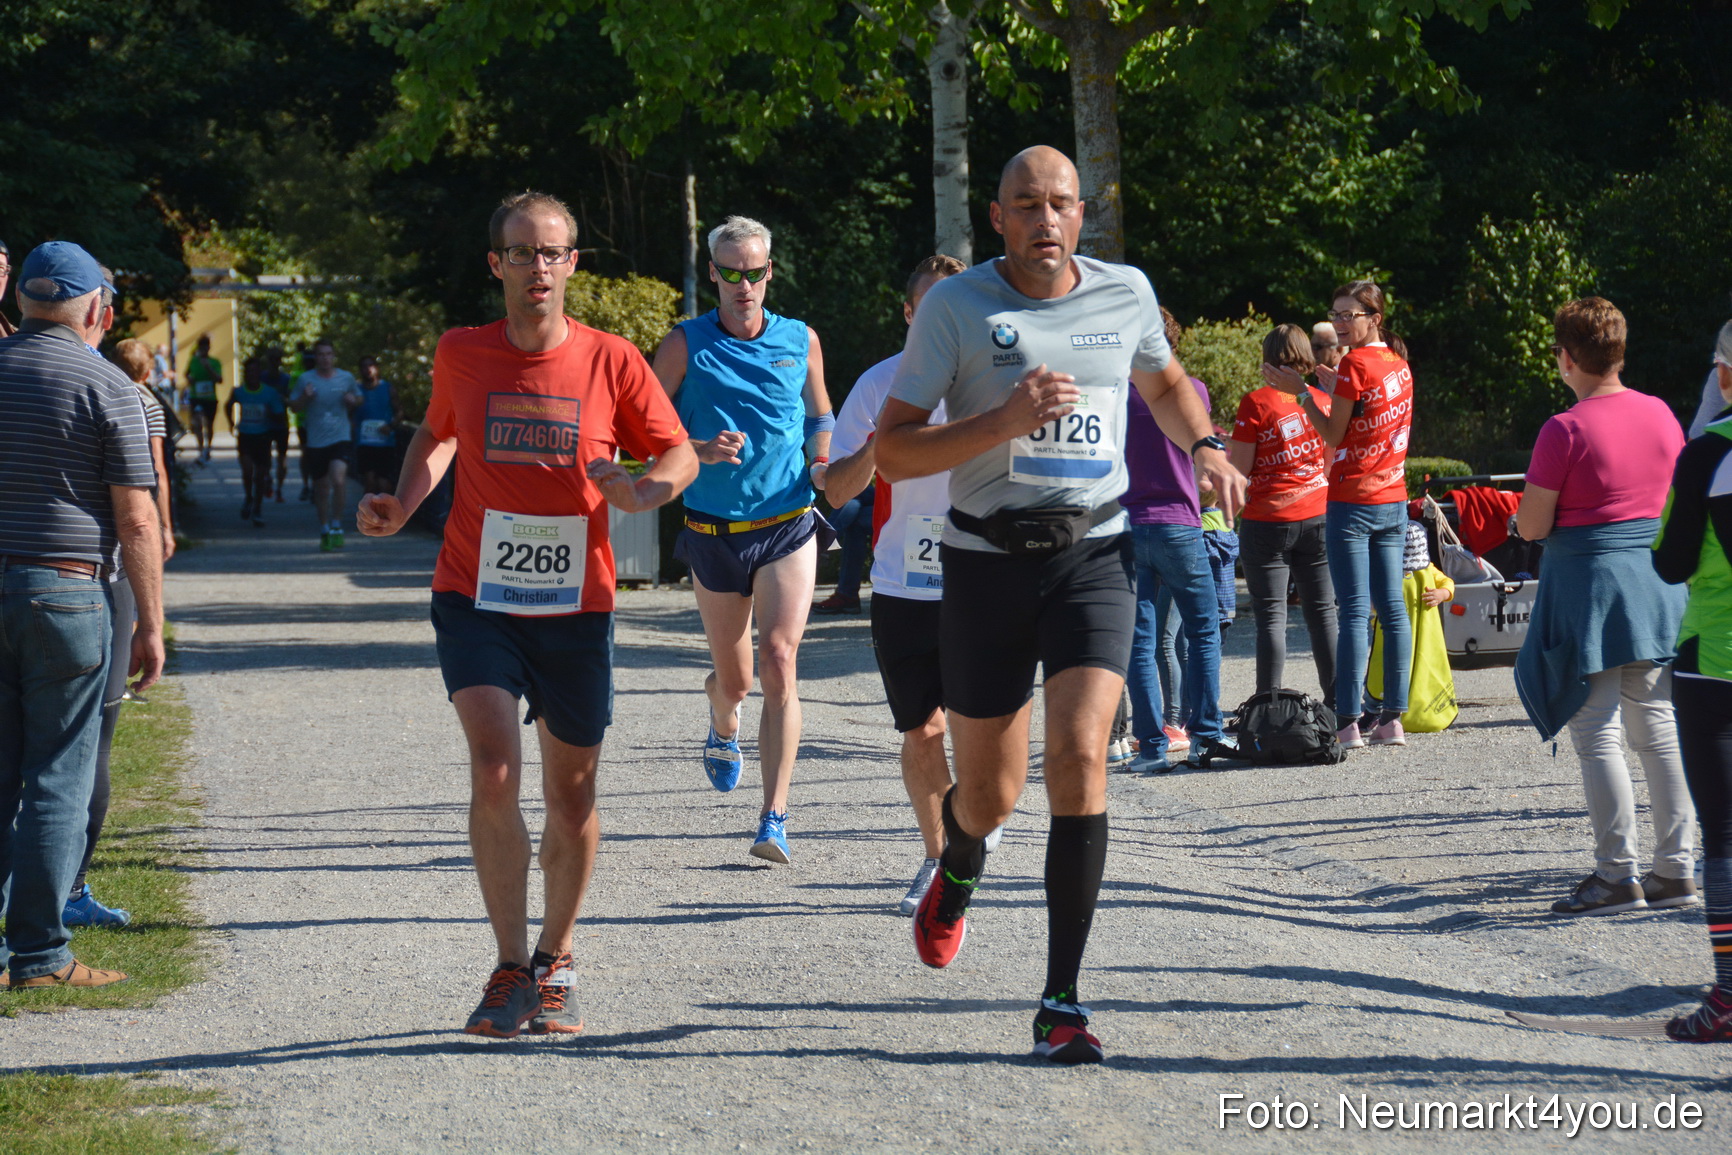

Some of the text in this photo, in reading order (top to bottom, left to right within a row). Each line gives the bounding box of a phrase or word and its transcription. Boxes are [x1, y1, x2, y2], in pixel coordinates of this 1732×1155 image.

[1071, 333, 1121, 346] BOCK
[992, 352, 1023, 362] PARTL
[490, 421, 574, 450] 0774600
[513, 524, 558, 537] BOCK
[495, 541, 571, 574] 2268
[501, 575, 523, 584] PARTL
[503, 588, 558, 604] Christian
